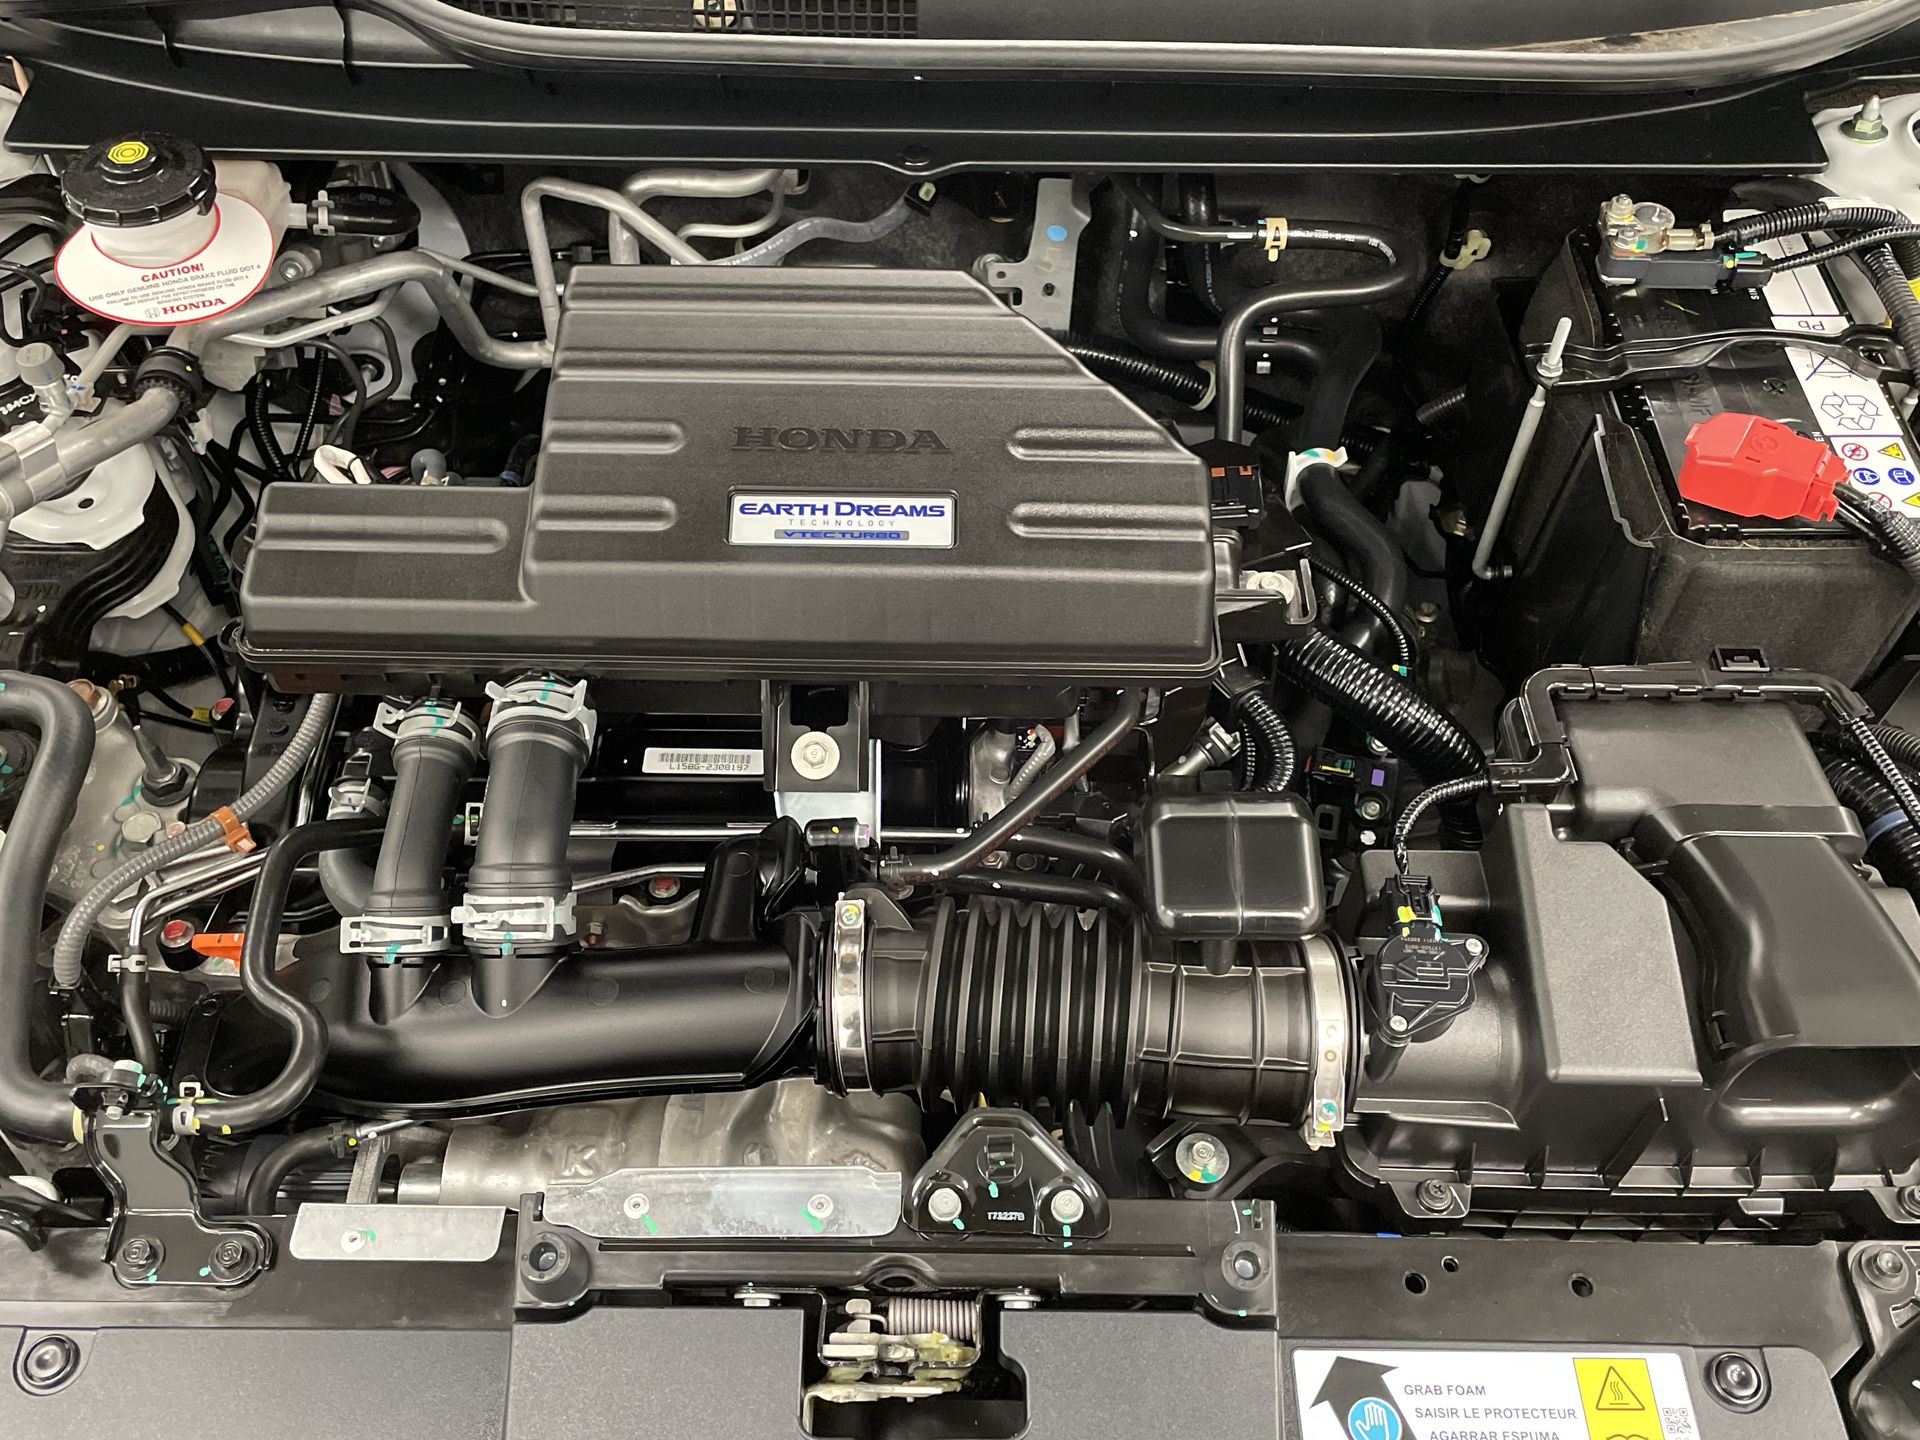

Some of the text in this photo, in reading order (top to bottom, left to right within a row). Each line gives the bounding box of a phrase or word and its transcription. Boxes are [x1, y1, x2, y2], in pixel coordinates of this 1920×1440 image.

[141, 263, 205, 282] CAUTION!
[88, 294, 104, 302] USE
[105, 290, 126, 298] ONLY
[127, 282, 160, 294] GENUINE
[162, 277, 189, 287] HONDA
[190, 271, 216, 281] BRAKE
[216, 267, 238, 277] FLUID
[239, 264, 255, 273] DOT
[162, 298, 227, 315] HONDA
[1797, 320, 1826, 331] Pb
[731, 426, 953, 453] HONDA
[739, 501, 945, 517] EARTH DREAMS
[788, 518, 896, 527] TECHNOLOGY
[783, 530, 901, 540] VTEC TURBO
[1404, 1384, 1487, 1396] GRAB FOAM
[1415, 1407, 1578, 1420] SAISIR LE PROTECTEUR
[1430, 1431, 1560, 1440] AGARRAR ESPUMA
